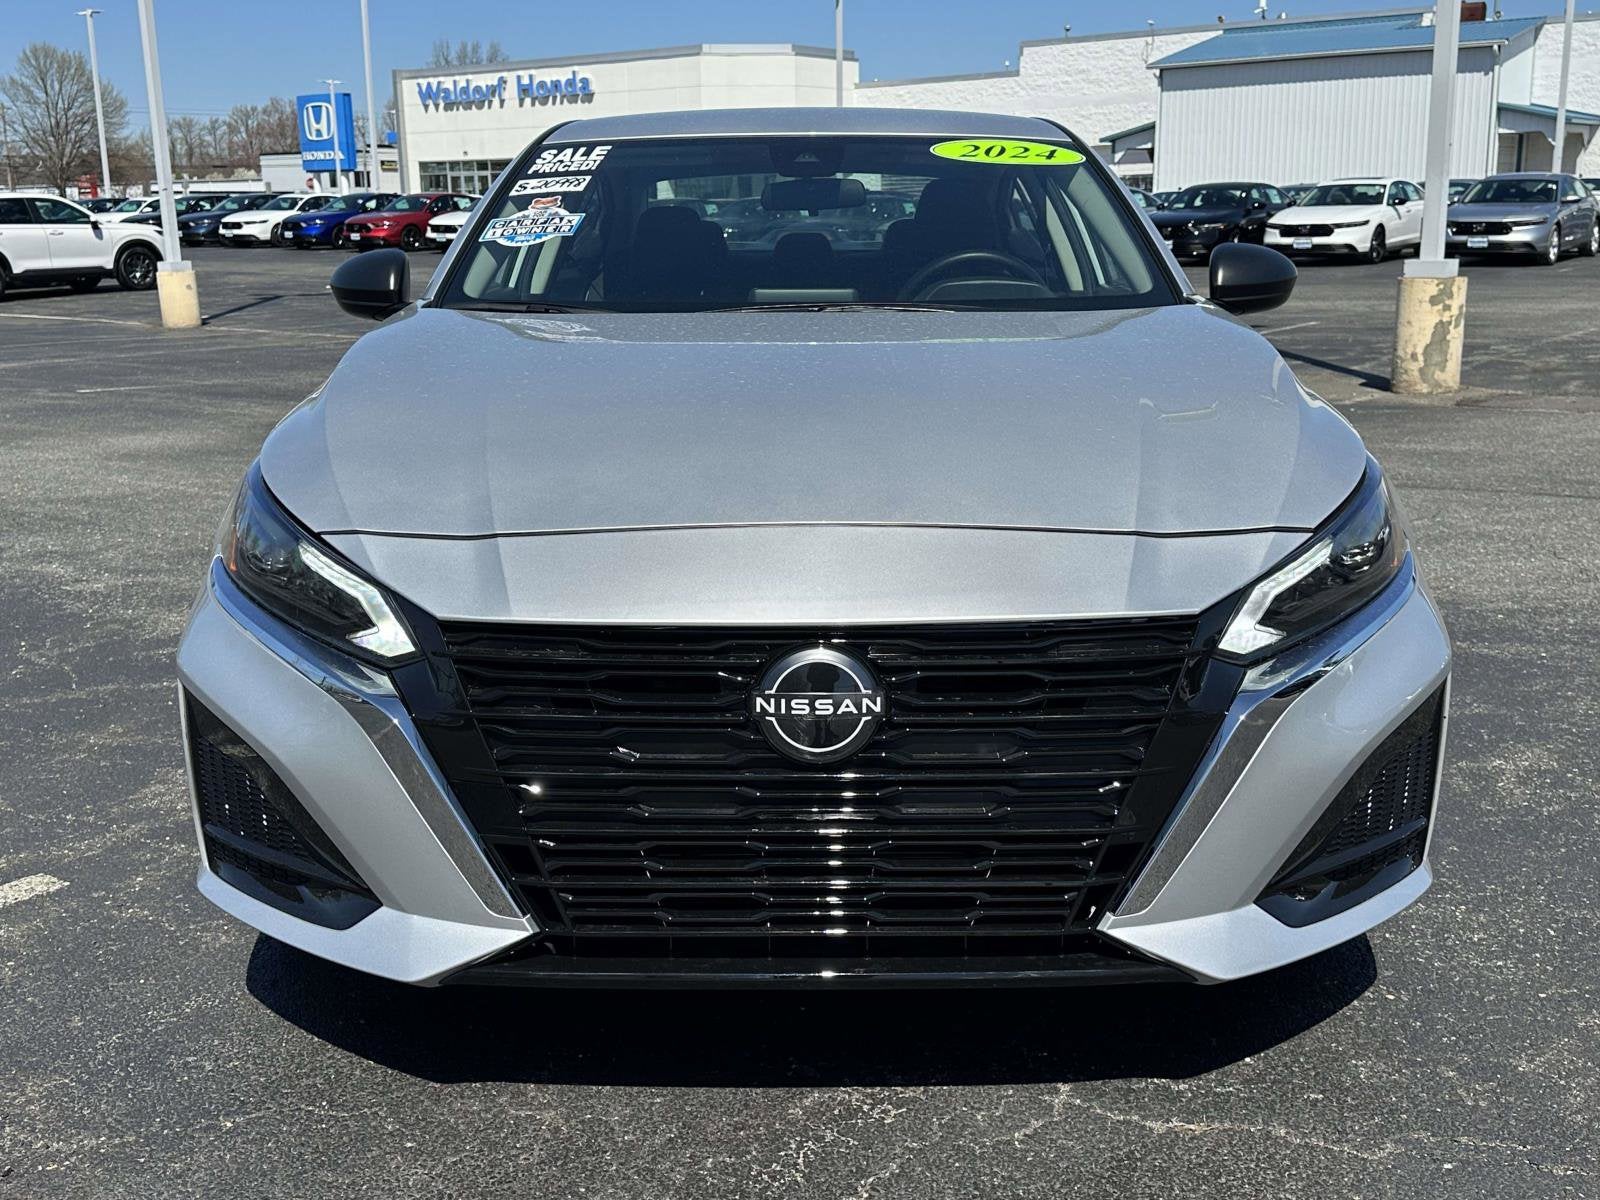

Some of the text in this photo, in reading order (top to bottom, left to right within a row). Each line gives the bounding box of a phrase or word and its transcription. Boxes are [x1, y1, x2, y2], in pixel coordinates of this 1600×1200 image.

[416, 70, 592, 105] Waldorf Honda
[536, 146, 613, 164] SALE
[959, 144, 1058, 161] 2024
[527, 159, 601, 174] PRICED!
[755, 696, 882, 716] NISSAN
